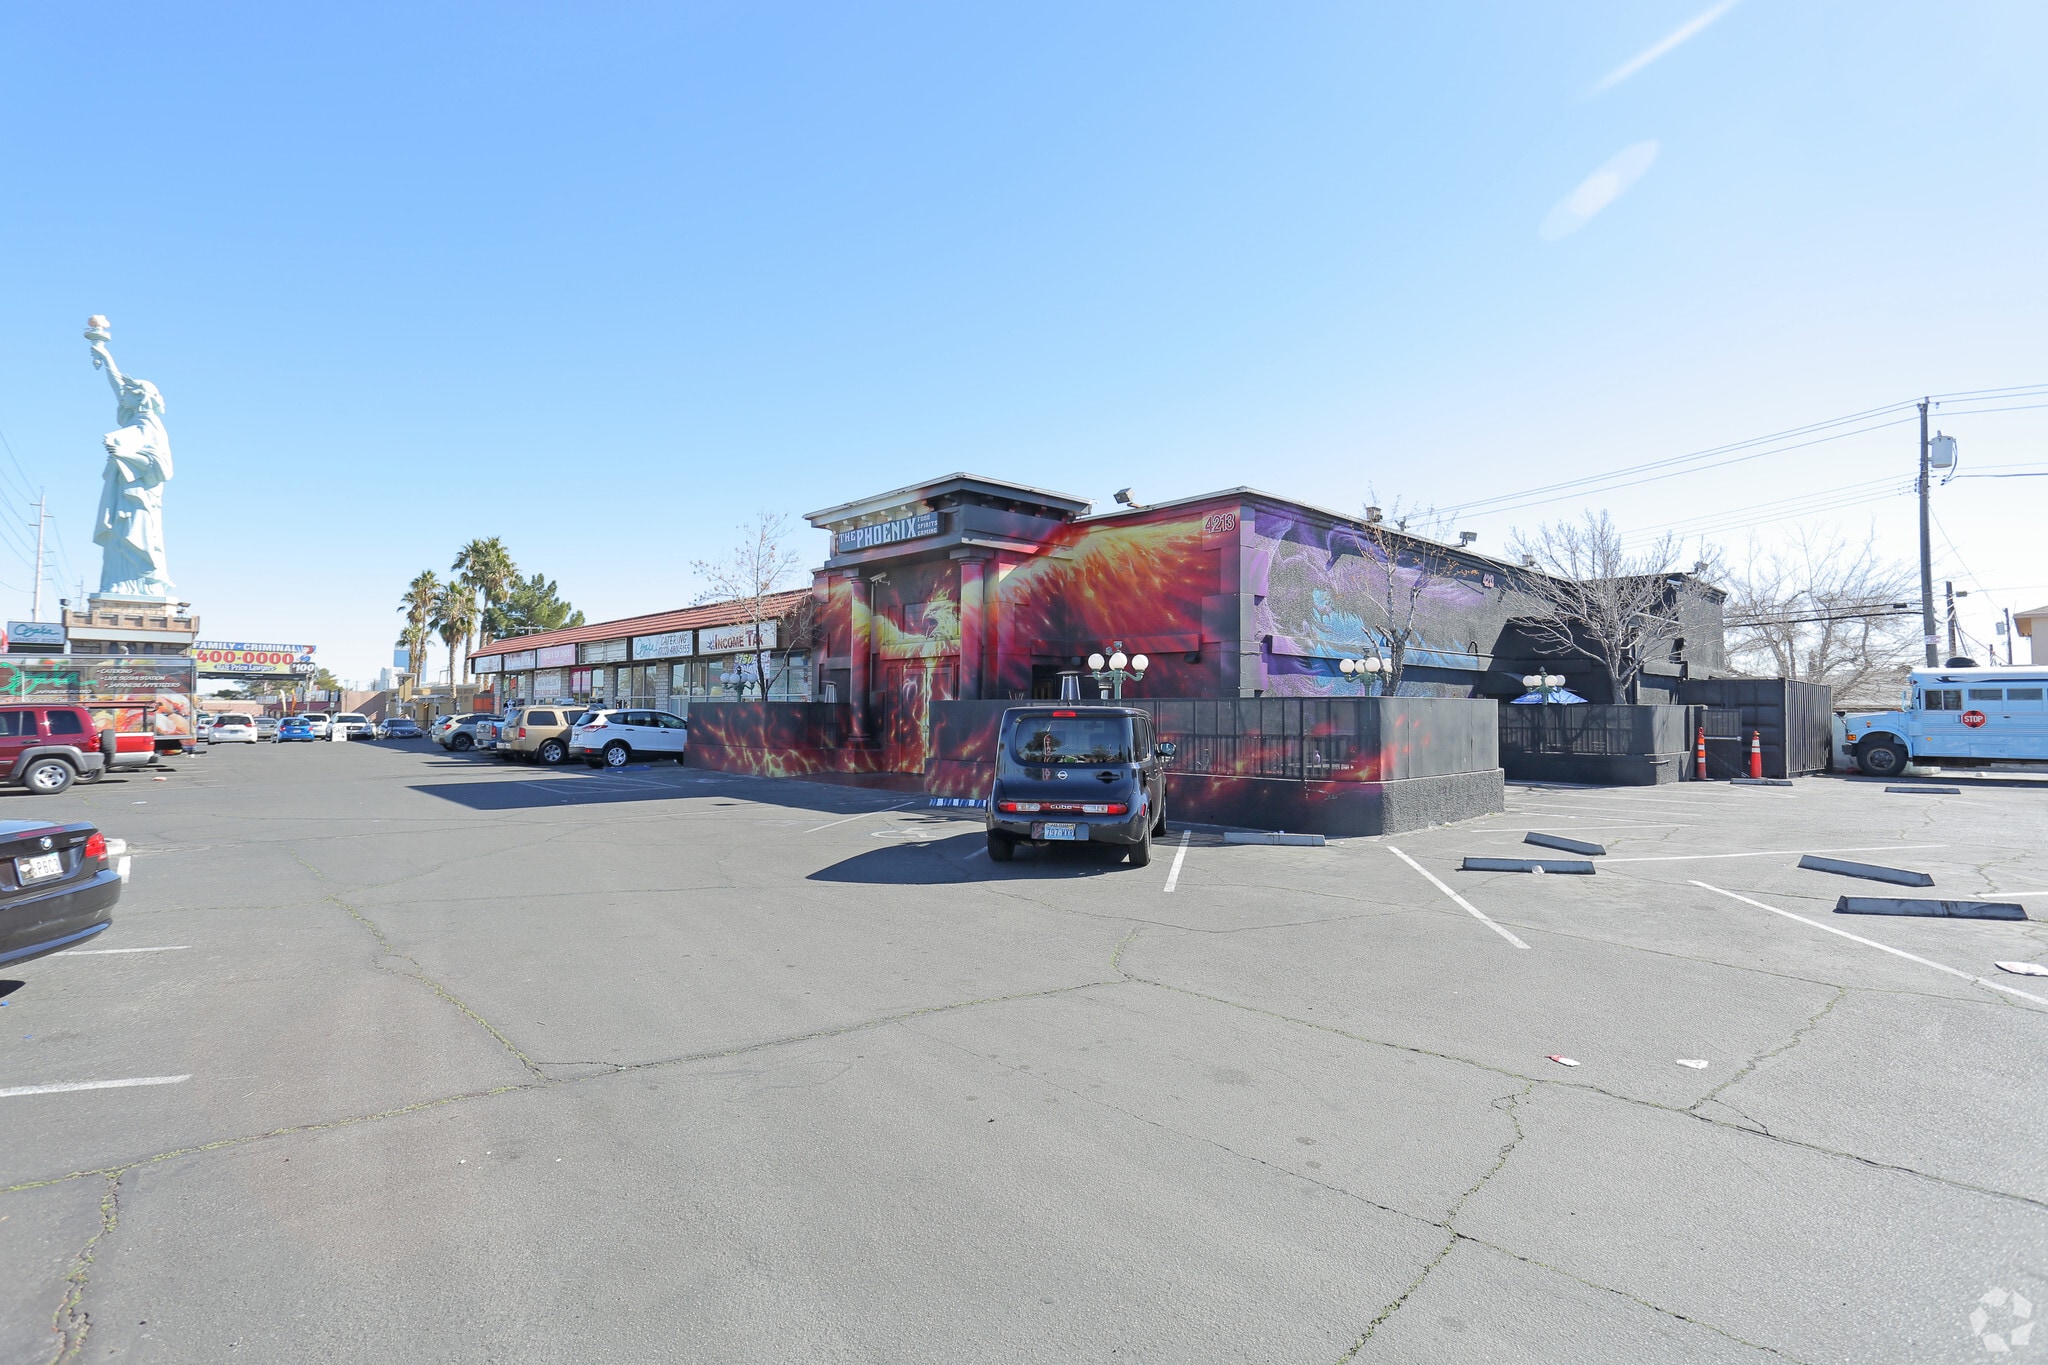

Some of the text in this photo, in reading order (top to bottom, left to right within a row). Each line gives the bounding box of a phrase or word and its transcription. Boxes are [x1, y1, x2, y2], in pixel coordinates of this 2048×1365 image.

[917, 514, 930, 522] FOOD
[1205, 512, 1236, 533] 4213
[917, 520, 938, 529] SPIRITS
[839, 517, 916, 548] THE PHOENIX
[917, 528, 938, 537] GAMING
[661, 633, 688, 646] CATERING
[714, 634, 744, 650] INCOME
[193, 641, 298, 652] FAMILY CRIMINAL
[231, 663, 248, 671] Price
[292, 663, 314, 672] $100
[1964, 715, 1984, 723] STOP
